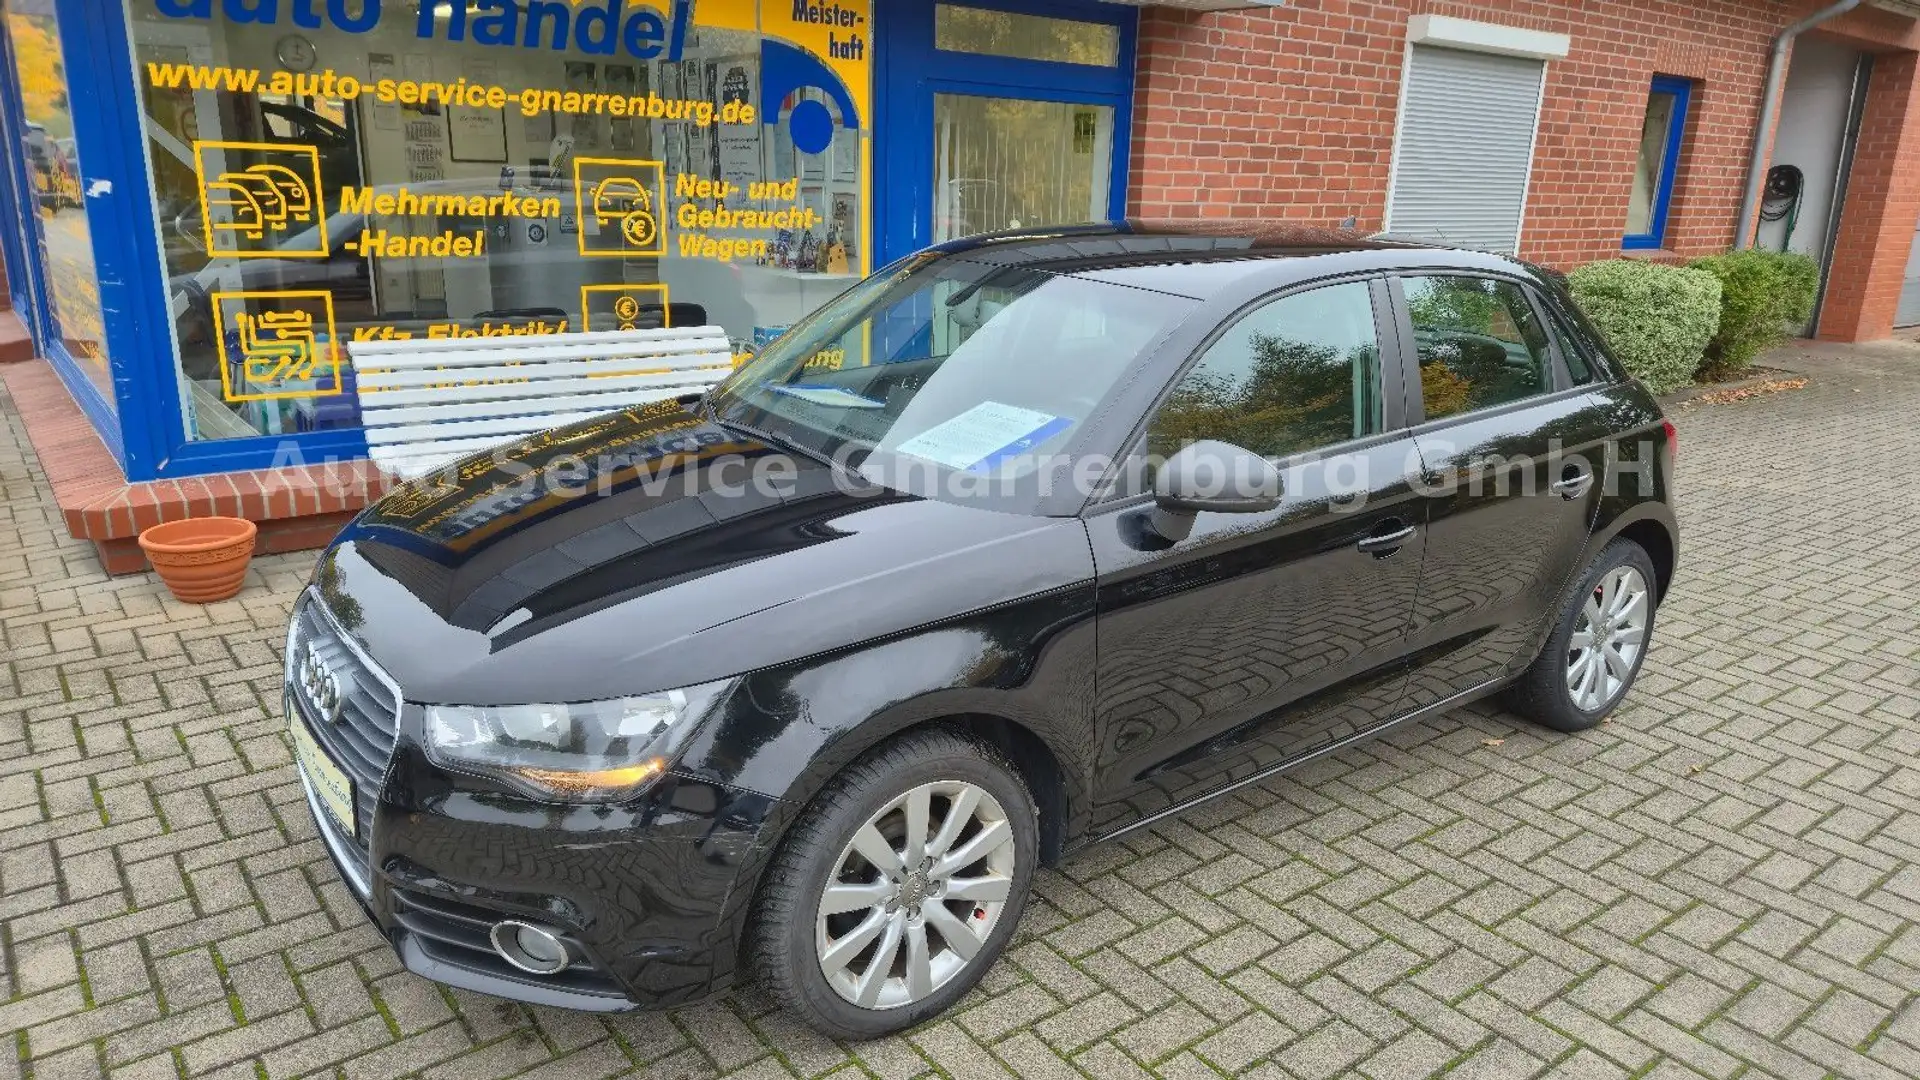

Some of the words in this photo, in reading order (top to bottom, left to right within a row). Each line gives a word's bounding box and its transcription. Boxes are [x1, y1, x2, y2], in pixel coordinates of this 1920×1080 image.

[791, 0, 864, 28] Meister-
[828, 31, 864, 61] haft
[147, 61, 756, 127] www.auto-service-gnarrenburg.de
[675, 173, 739, 200] Neu-
[748, 177, 798, 201] und
[339, 185, 561, 218] Mehrmarken
[677, 203, 822, 230] Gebraucht-
[344, 229, 484, 257] -Handel
[678, 233, 766, 262] Wagen
